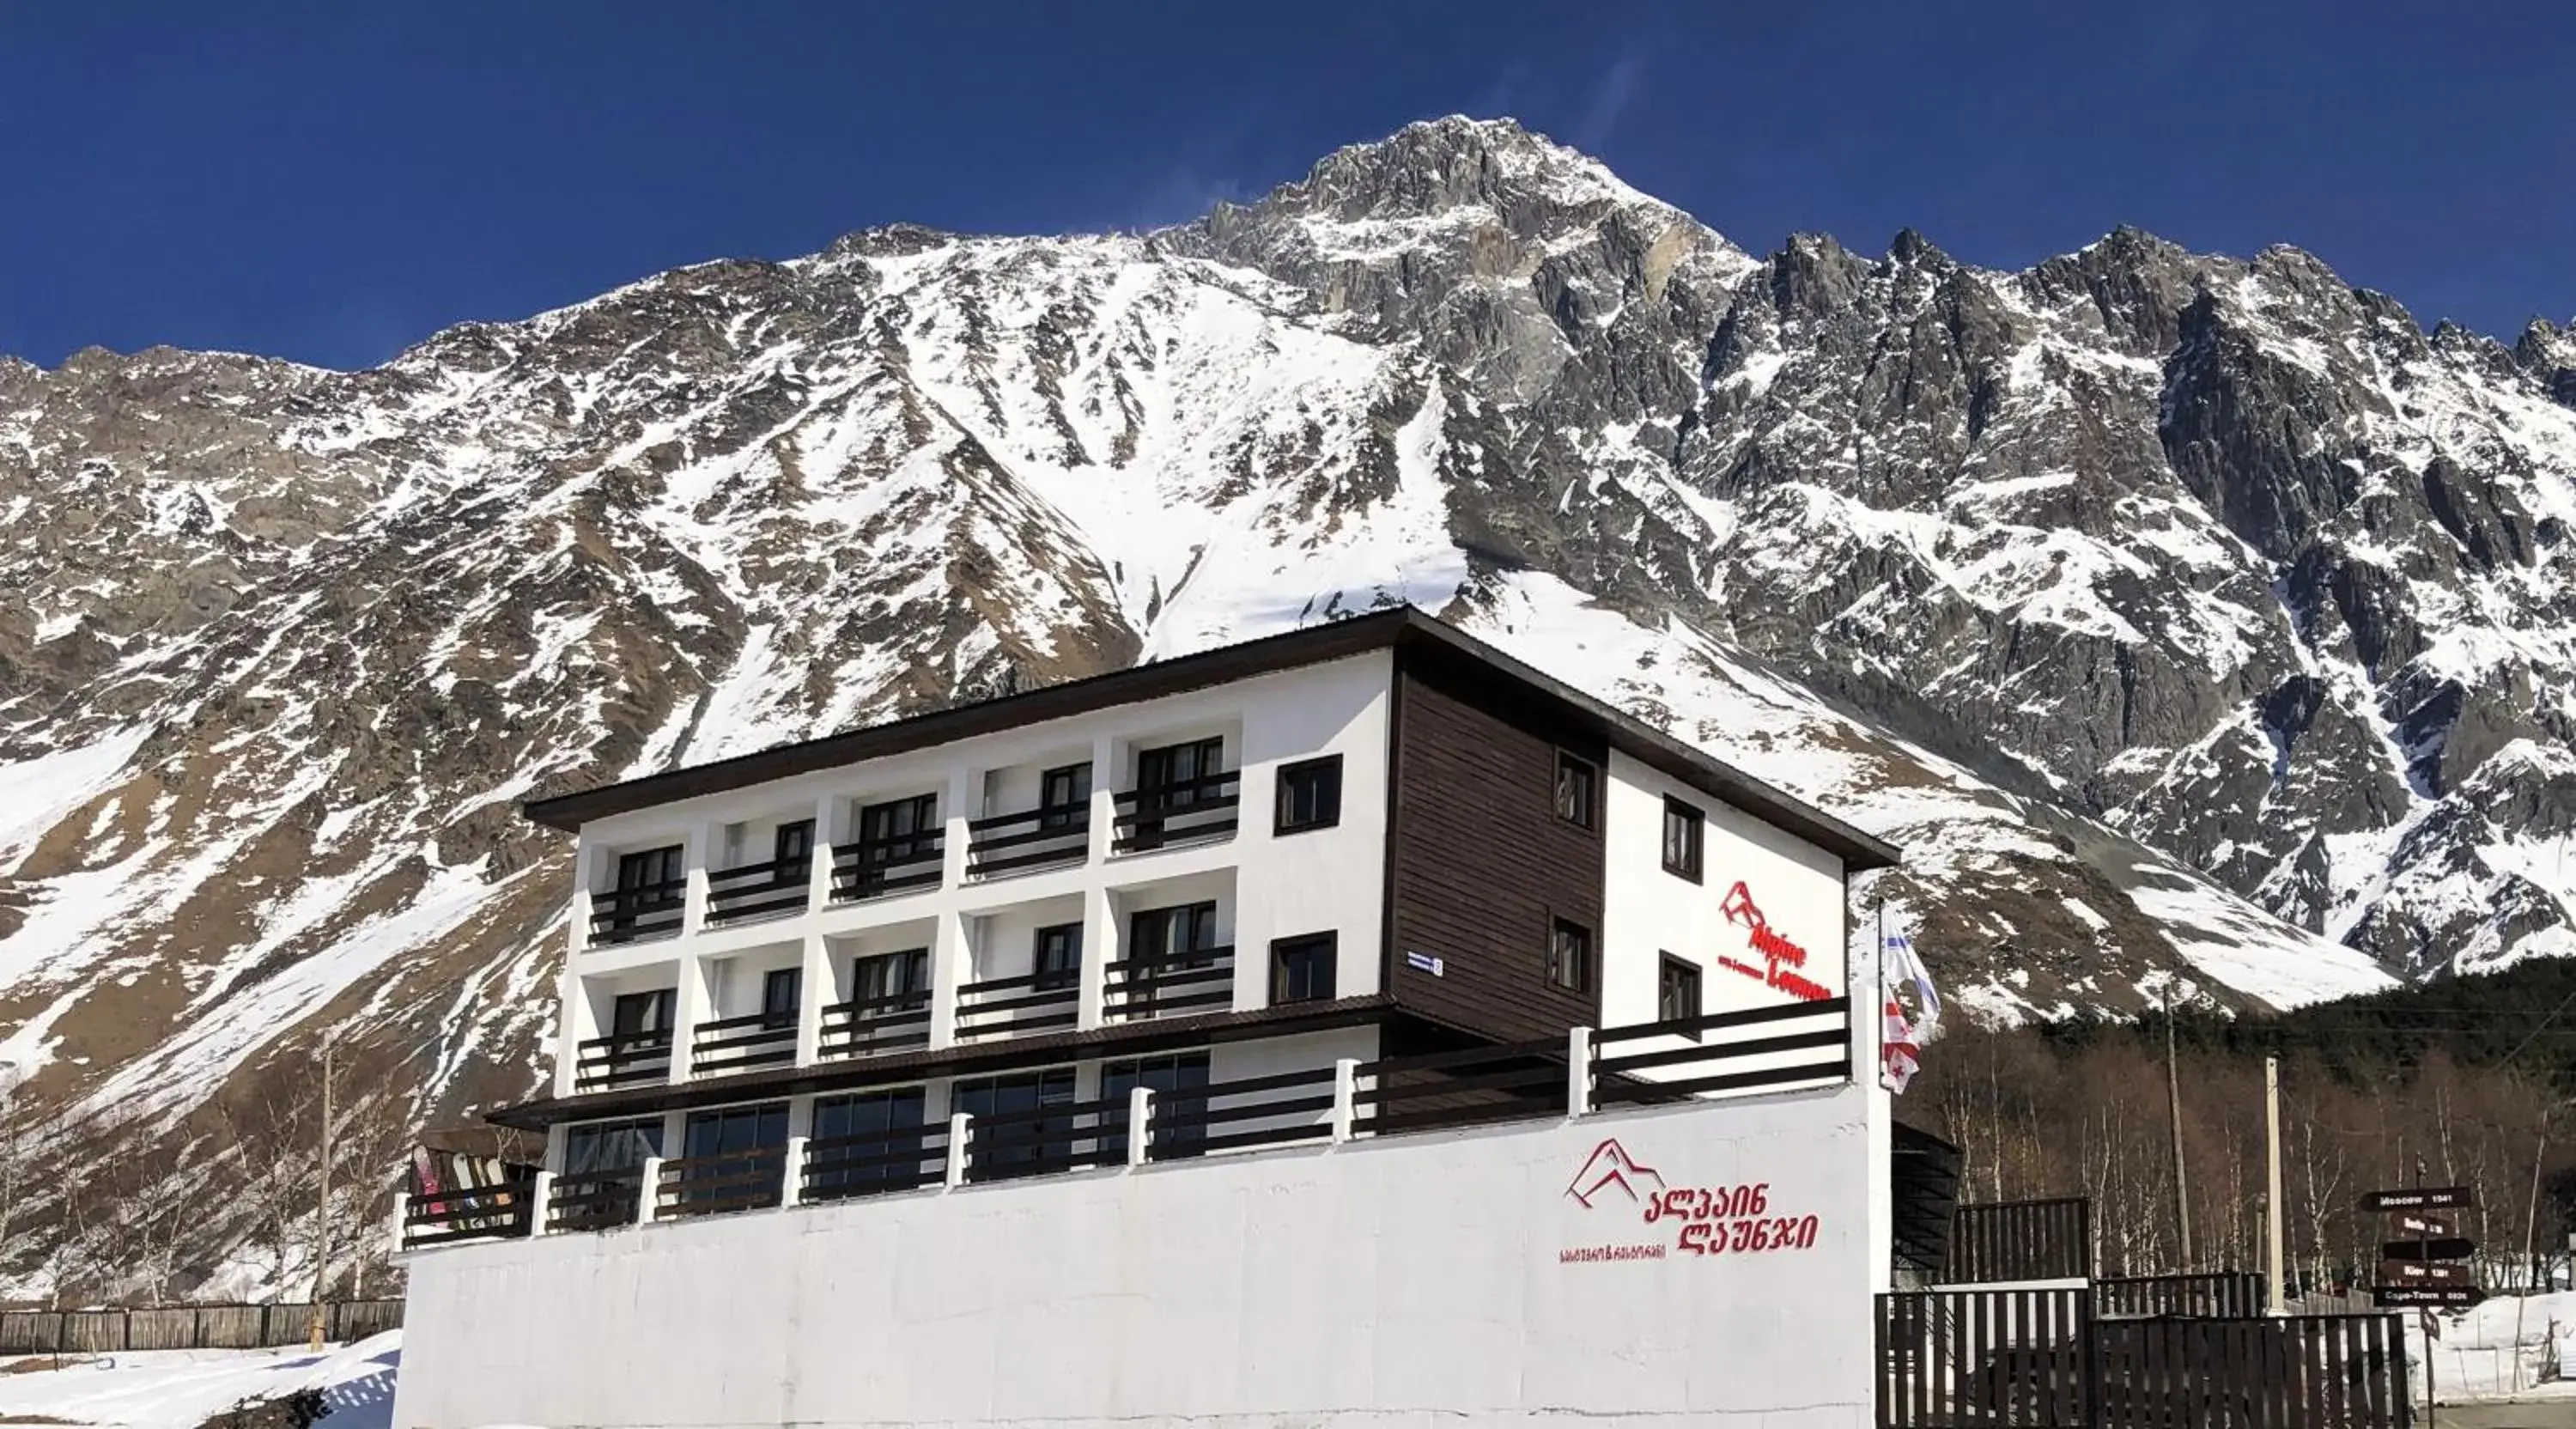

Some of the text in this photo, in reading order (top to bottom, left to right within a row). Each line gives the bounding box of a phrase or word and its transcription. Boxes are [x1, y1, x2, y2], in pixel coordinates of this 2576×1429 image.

[1747, 922, 1807, 969] Alpine
[1644, 1183, 1770, 1222] ალპაინ
[2379, 1196, 2423, 1207] Moscow
[1678, 1215, 1819, 1254] ლაუნჯი
